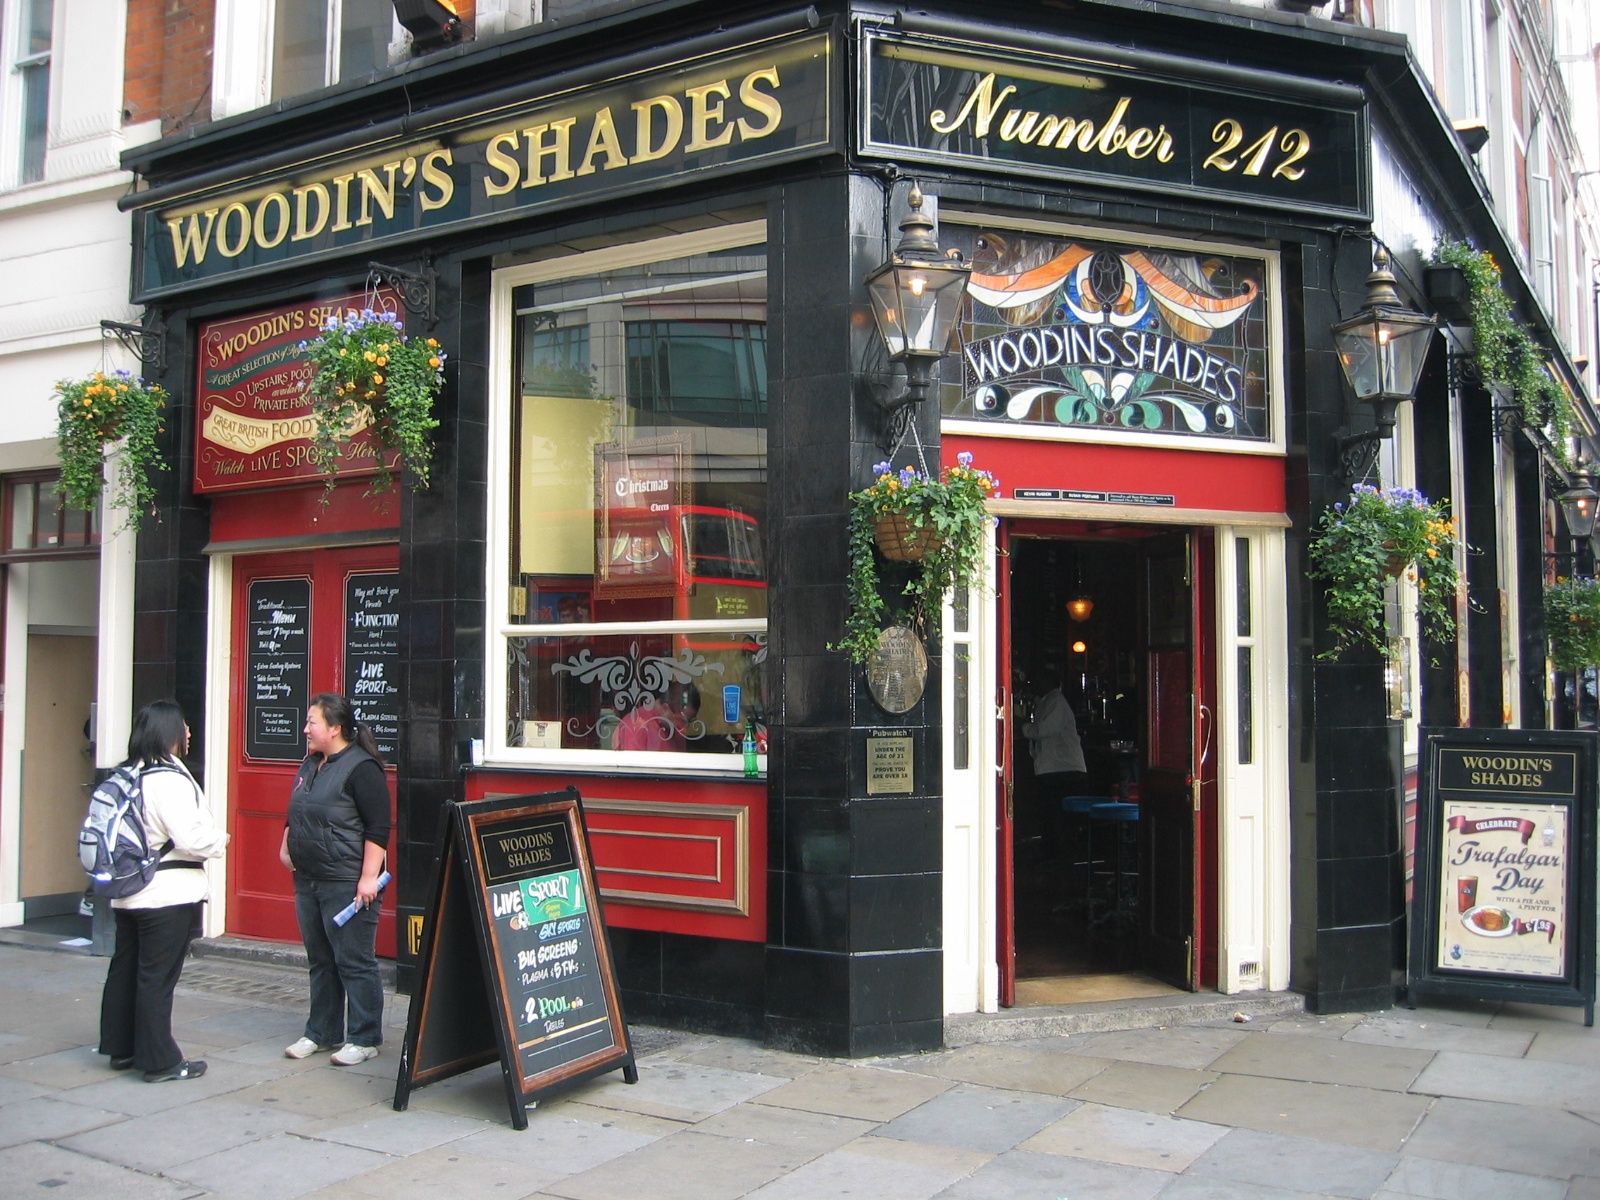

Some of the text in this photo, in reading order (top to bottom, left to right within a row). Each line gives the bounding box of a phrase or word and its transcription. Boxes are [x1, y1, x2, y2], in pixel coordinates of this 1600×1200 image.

[930, 72, 1311, 182] Number 212
[167, 64, 783, 269] WOODIN'S SHADES
[217, 310, 304, 361] WOODIN'S
[219, 367, 241, 386] GREAT
[241, 350, 280, 375] SELECTION
[279, 345, 289, 362] of
[290, 367, 315, 381] POOL
[966, 327, 1243, 402] WOODINS SHADES
[253, 396, 288, 413] PRIVATE
[213, 413, 312, 441] GREAT BRITISH FOOD
[213, 458, 245, 476] Watch
[251, 450, 281, 472] LIVE
[286, 445, 328, 468] SPOR
[615, 477, 669, 497] Christmas
[650, 503, 670, 512] Cheers
[272, 610, 297, 624] Menu
[273, 626, 280, 639] 7
[361, 661, 384, 678] LIVE
[355, 679, 388, 694] SPORT
[353, 707, 361, 721] 2
[1461, 756, 1553, 772] WOODIN'S
[1471, 772, 1542, 787] SHADES
[1475, 820, 1518, 830] CELEBRATE
[498, 831, 554, 853] WOODINS
[507, 847, 552, 868] SHADES
[1450, 840, 1560, 871] Trafalgar
[1491, 867, 1544, 894] Day
[493, 875, 570, 917] LIVE SPORT
[538, 917, 581, 940] SKY SPORTS
[1525, 918, 1551, 933] £7.95
[517, 938, 578, 971] BIG SCREENS
[522, 967, 549, 986] PLASMA
[525, 995, 571, 1024] 2 POOL
[544, 1017, 565, 1034] TABLES
